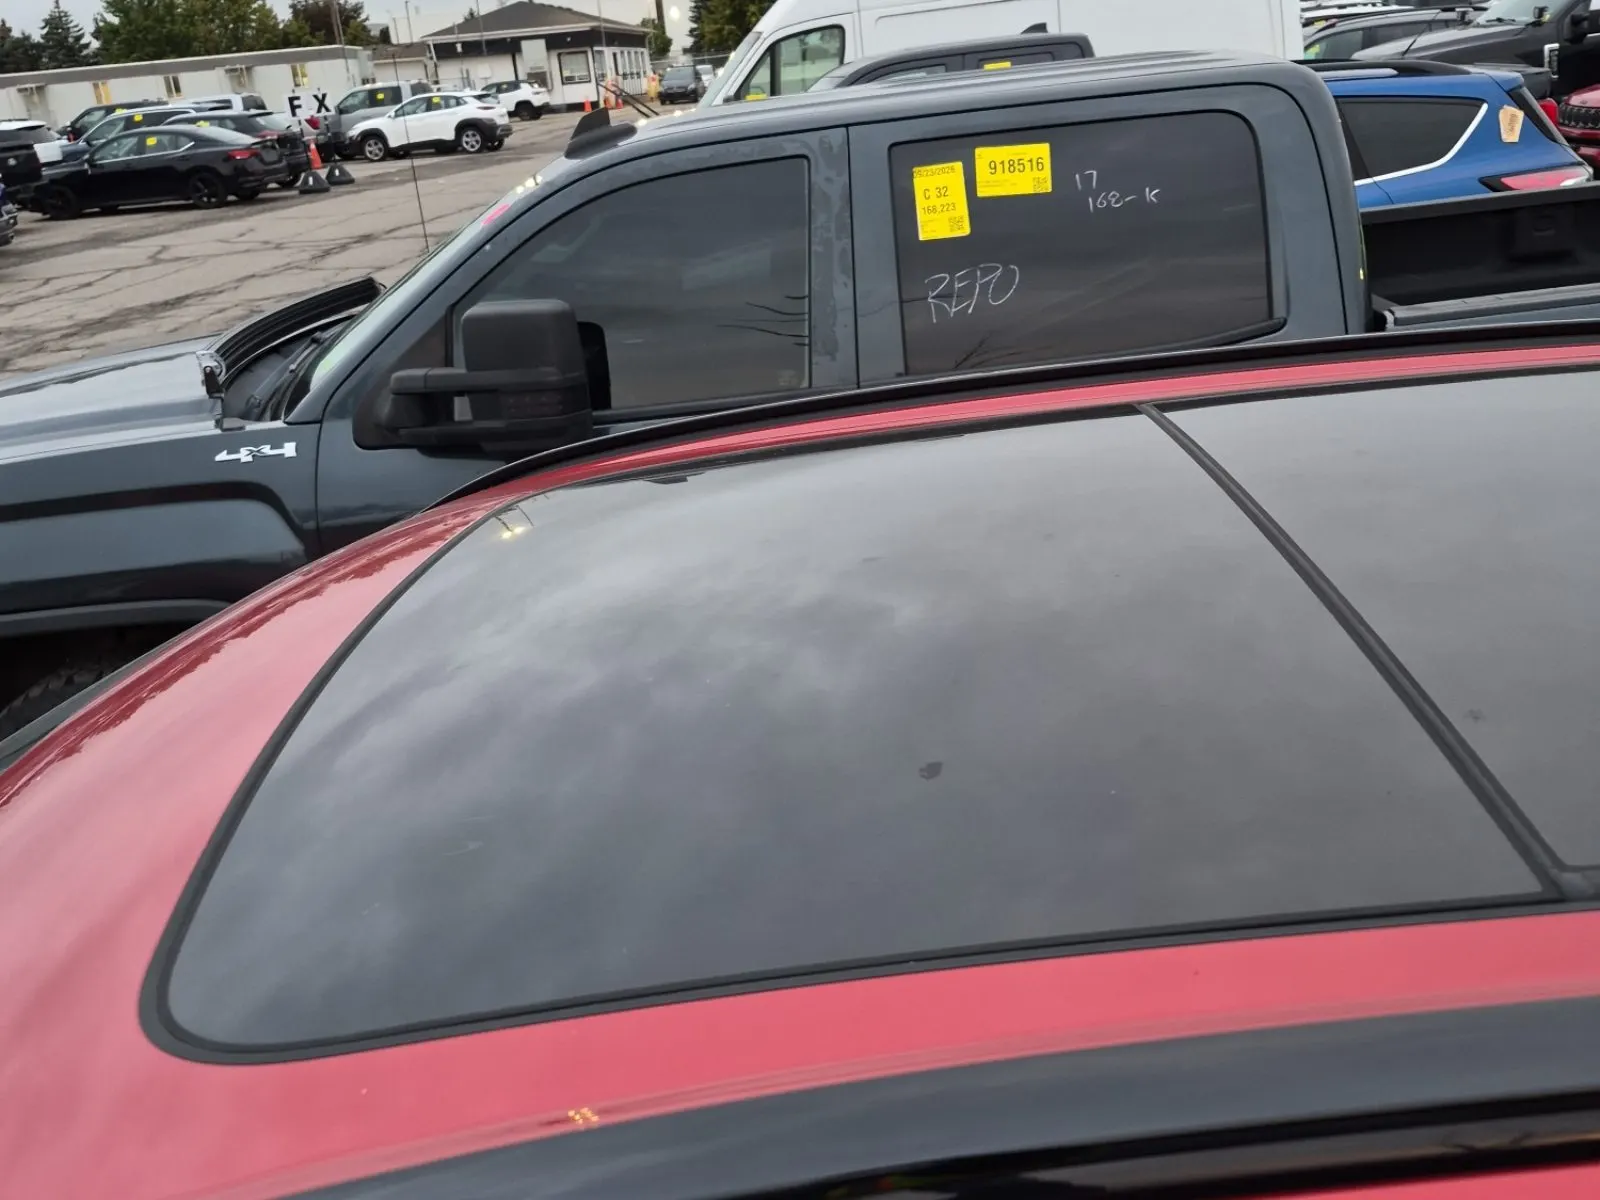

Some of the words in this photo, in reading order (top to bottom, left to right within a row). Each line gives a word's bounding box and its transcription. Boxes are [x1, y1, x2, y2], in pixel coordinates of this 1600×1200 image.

[288, 96, 302, 117] F
[312, 93, 331, 113] X
[989, 157, 1044, 175] 918516
[1075, 170, 1097, 190] 17
[923, 188, 931, 200] C
[935, 185, 949, 198] 32
[924, 262, 1020, 323] REPO
